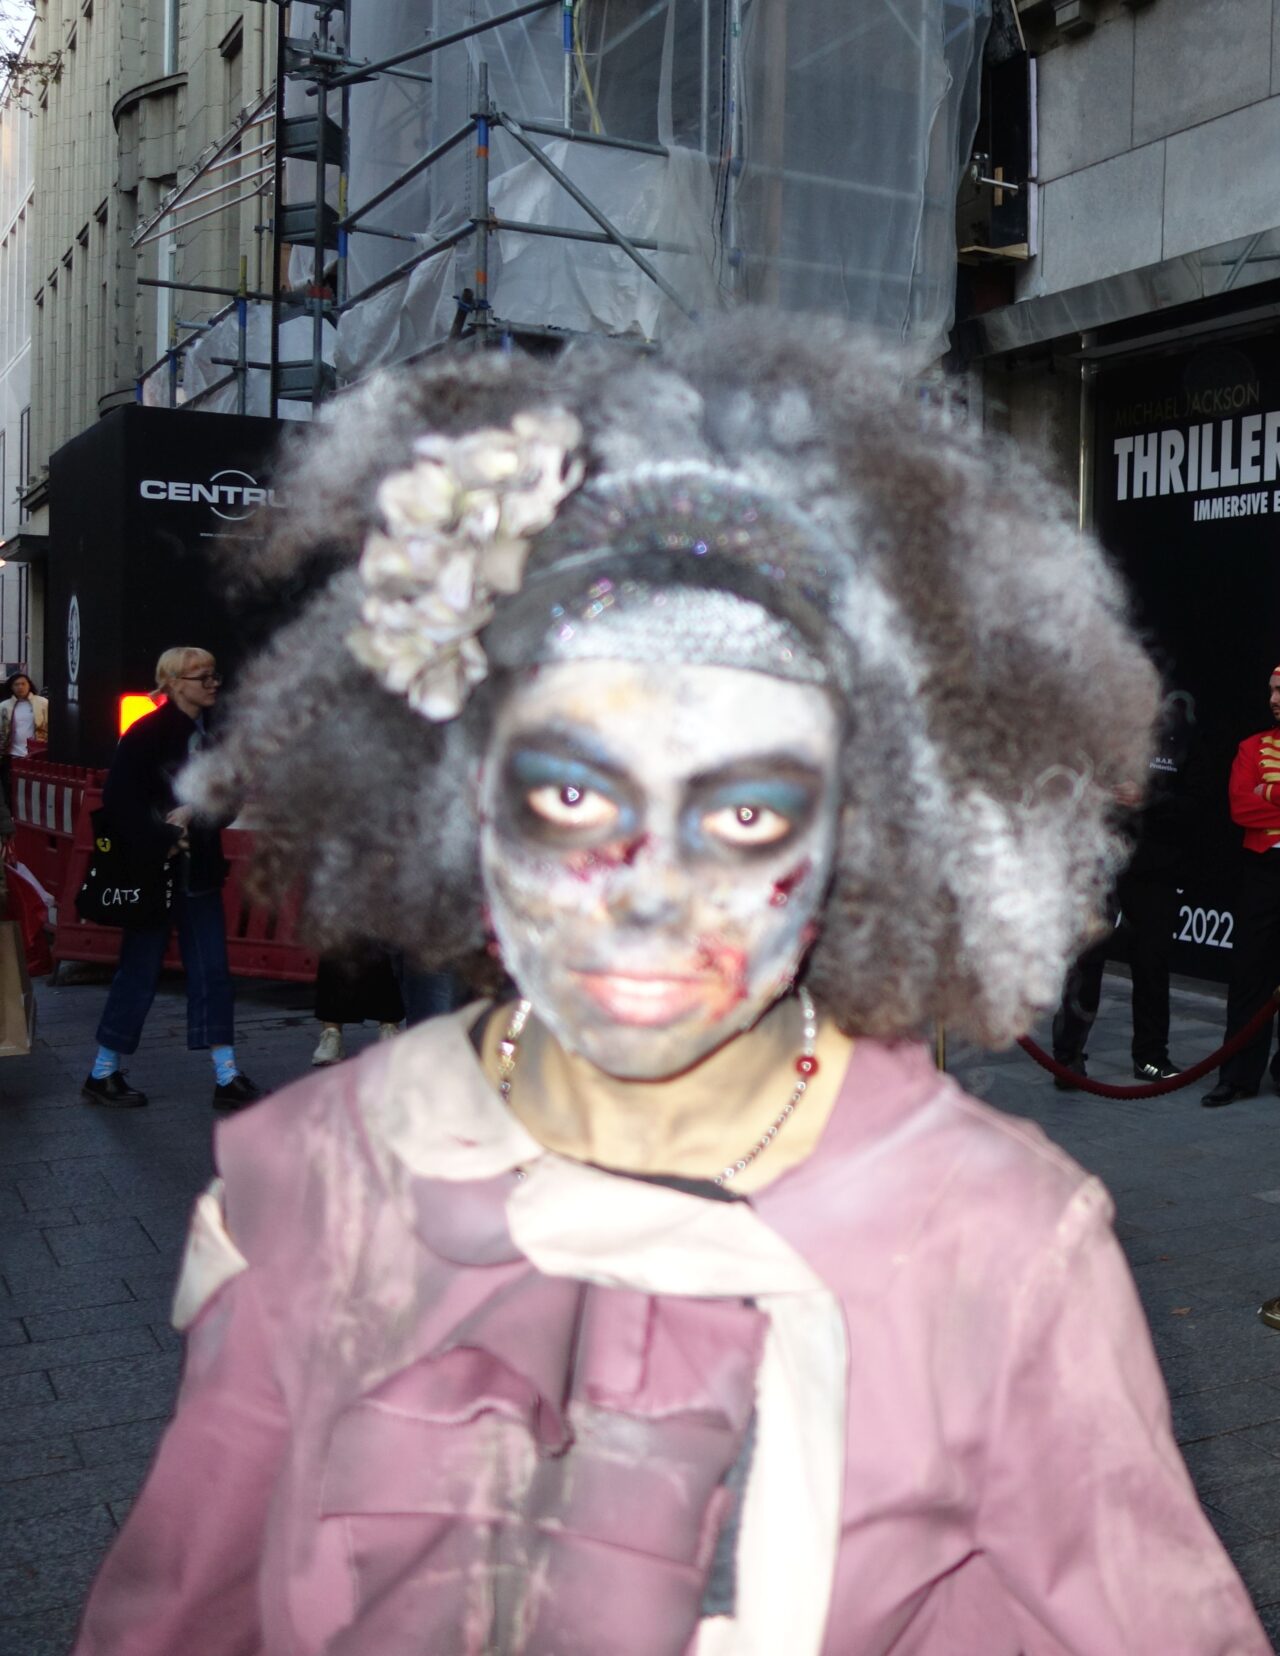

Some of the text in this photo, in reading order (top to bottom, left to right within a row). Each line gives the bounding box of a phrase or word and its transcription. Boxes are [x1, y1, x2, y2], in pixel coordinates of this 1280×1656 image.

[1114, 379, 1261, 428] MICHAEL JACKSON
[139, 479, 292, 508] CENTRU
[1193, 491, 1269, 522] IMMERSIVE
[101, 887, 141, 906] CATS
